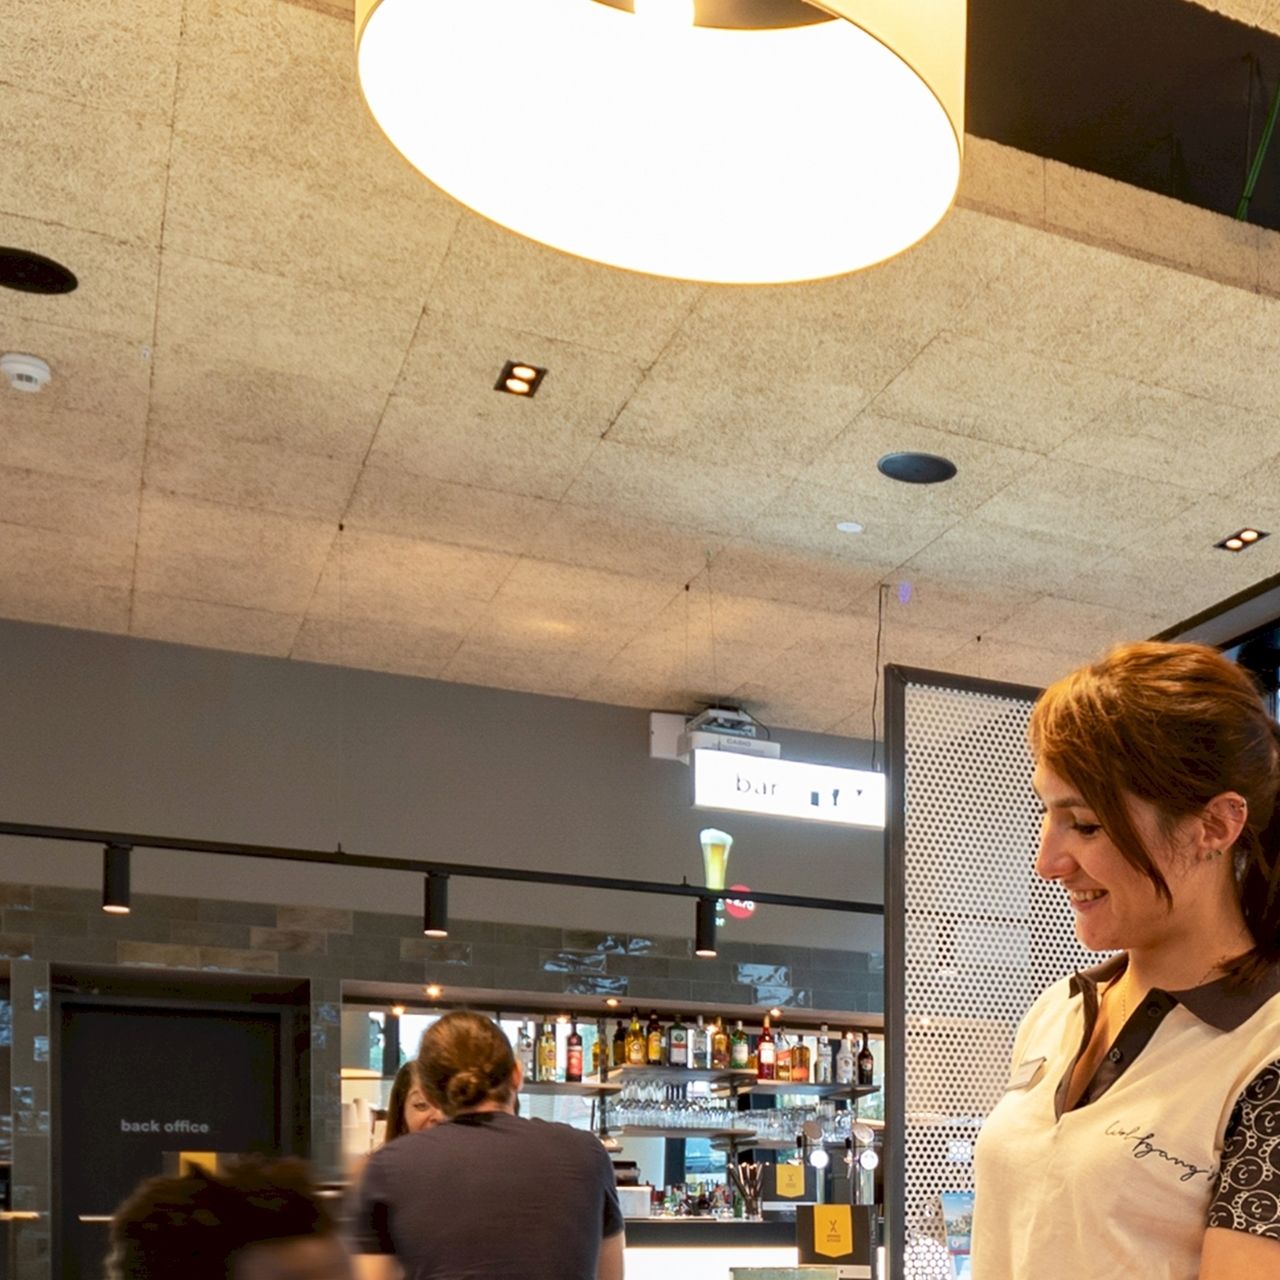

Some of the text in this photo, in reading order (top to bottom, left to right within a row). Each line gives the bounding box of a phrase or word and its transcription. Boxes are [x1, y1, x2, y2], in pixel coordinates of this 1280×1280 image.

[736, 773, 777, 796] bar
[120, 1119, 210, 1133] back office
